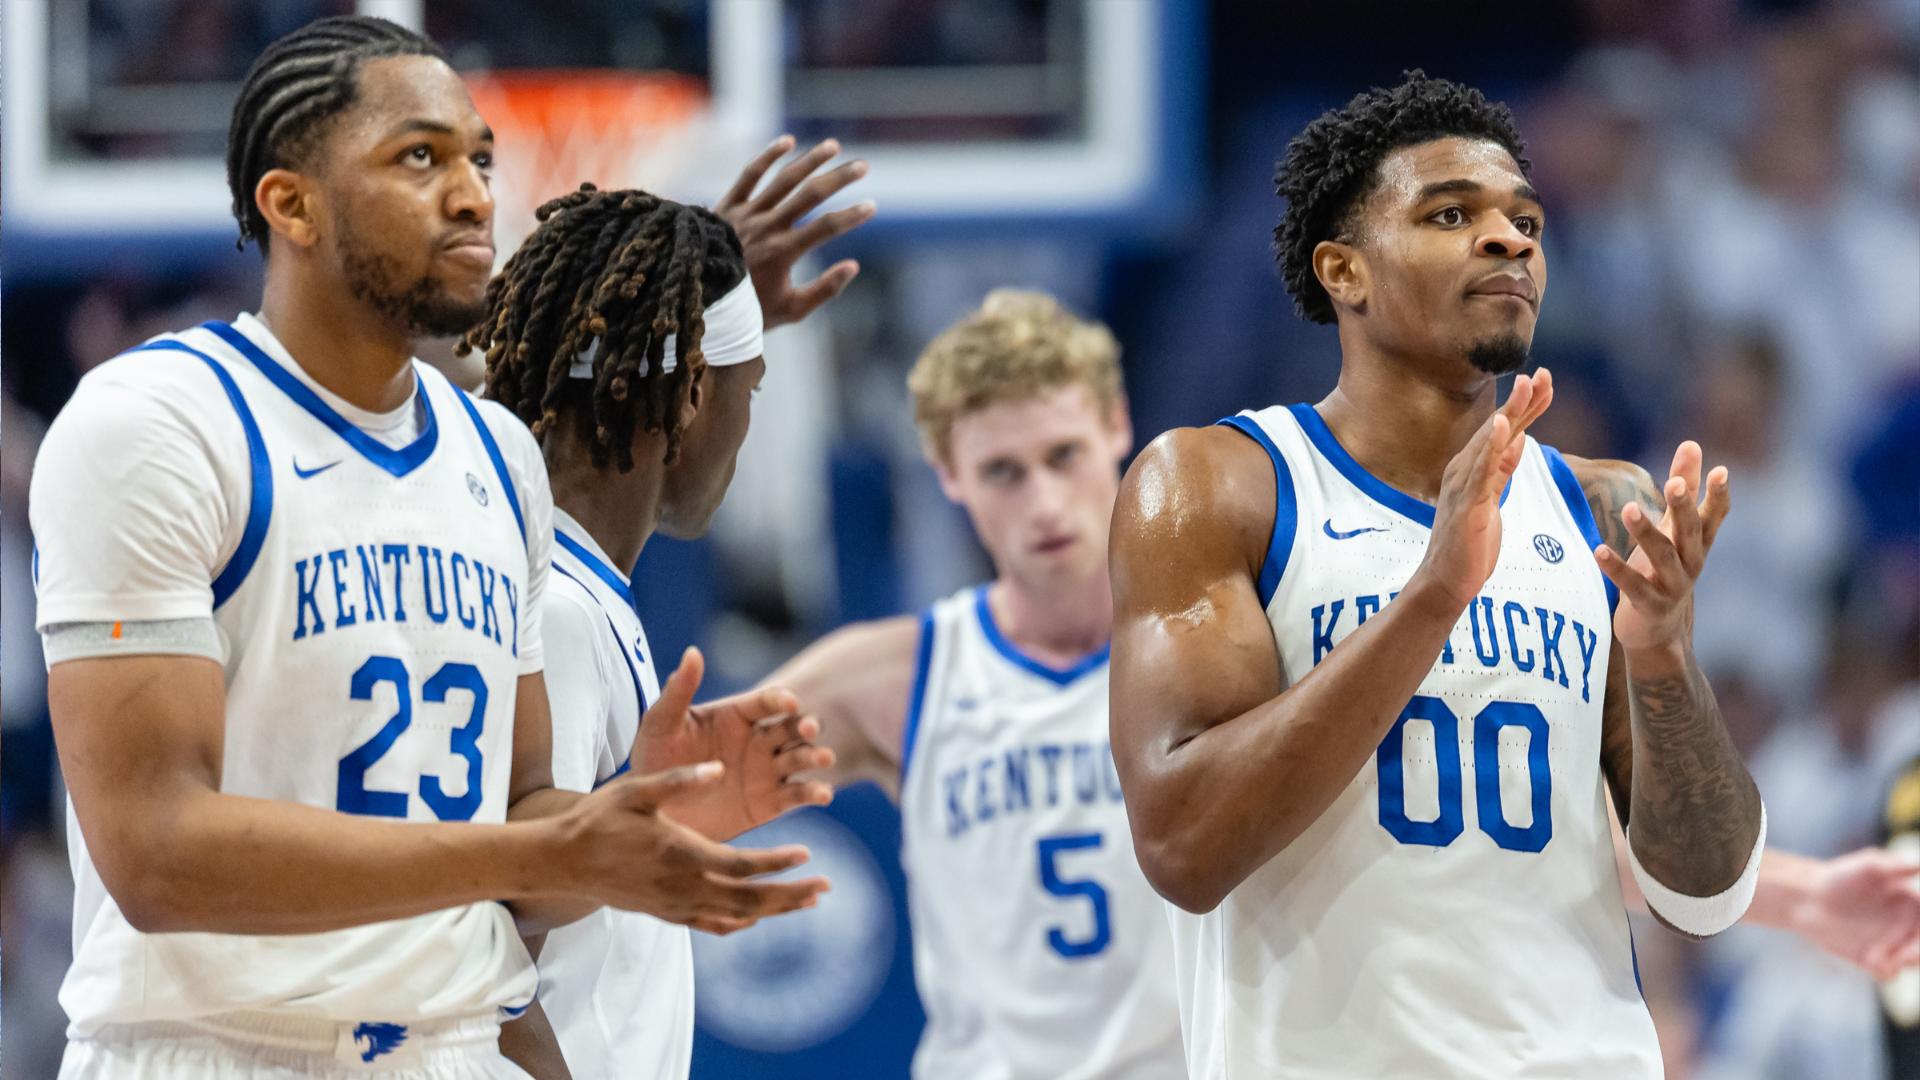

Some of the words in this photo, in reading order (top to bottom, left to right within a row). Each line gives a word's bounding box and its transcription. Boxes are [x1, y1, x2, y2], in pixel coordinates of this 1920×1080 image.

[293, 544, 518, 659] KENTUCKY
[1534, 535, 1563, 562] SEC
[1311, 592, 1596, 703] KUCKY
[336, 655, 488, 821] 23
[1376, 695, 1552, 853] 00
[1036, 831, 1112, 959] 5
